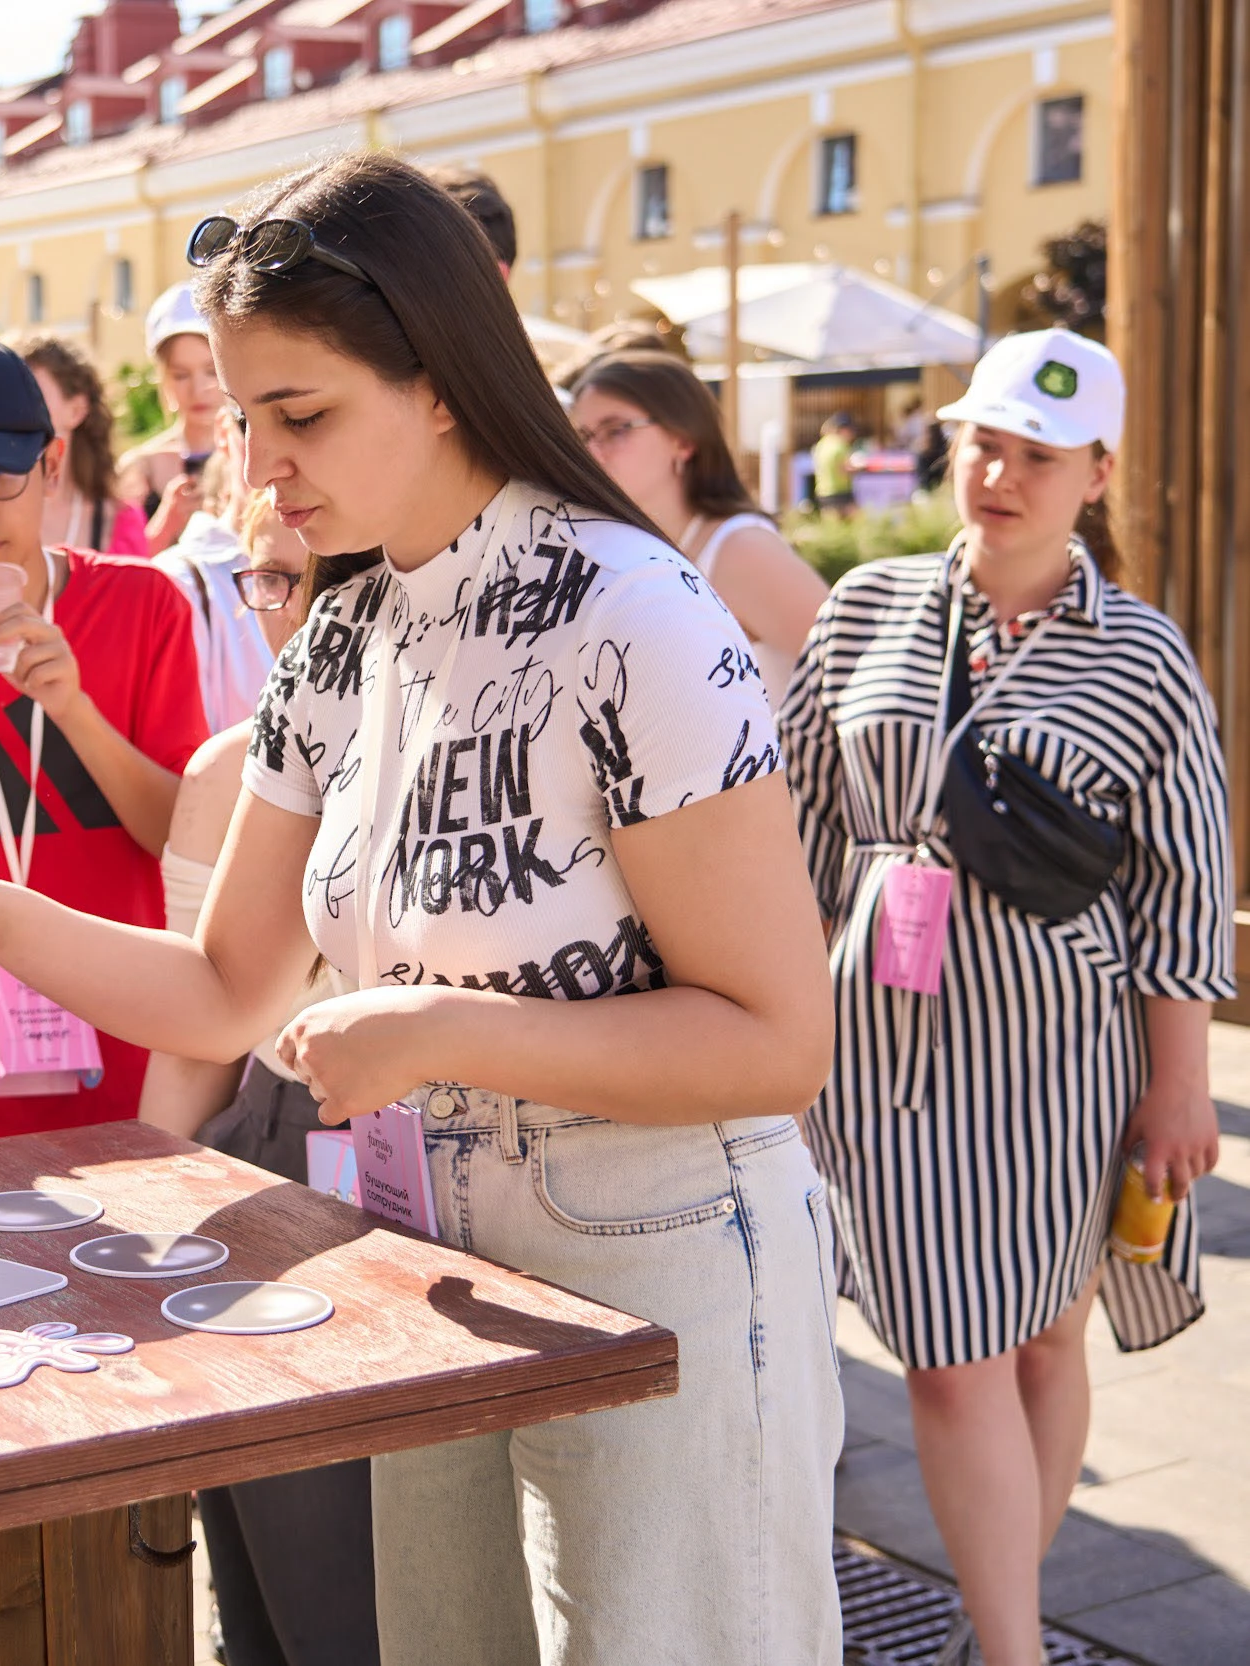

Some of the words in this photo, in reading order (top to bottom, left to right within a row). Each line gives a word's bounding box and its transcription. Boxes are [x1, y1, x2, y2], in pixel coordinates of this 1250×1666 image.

[471, 655, 563, 742] city
[399, 723, 534, 835] NEW
[396, 817, 568, 915] YORK
[367, 1131, 393, 1158] family
[365, 1171, 410, 1202] бушующий
[366, 1189, 413, 1219] сотрудник
